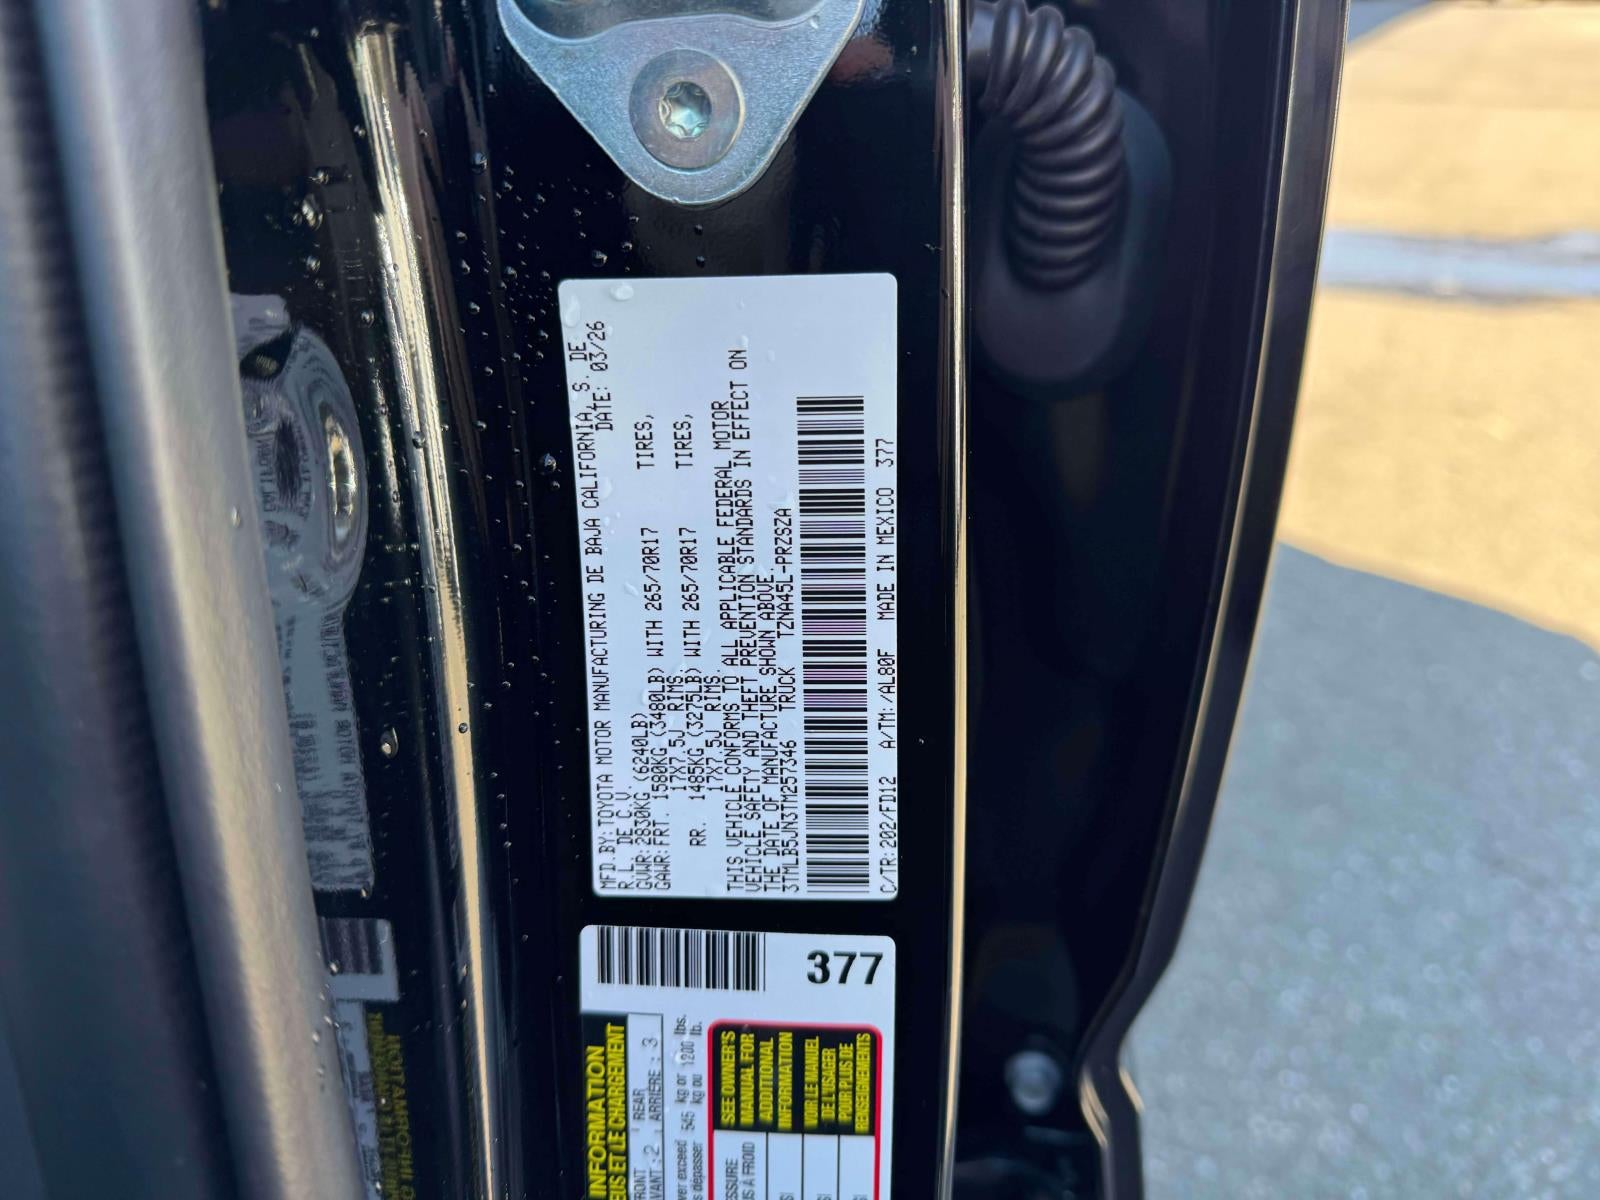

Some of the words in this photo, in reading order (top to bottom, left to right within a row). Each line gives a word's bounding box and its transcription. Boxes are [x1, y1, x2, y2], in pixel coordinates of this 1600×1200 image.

[568, 342, 587, 361] DE
[586, 321, 608, 372] 03/26
[728, 349, 748, 370] ON
[572, 375, 590, 392] S.
[592, 386, 613, 431] DATE:
[711, 401, 731, 449] MOTOR
[730, 381, 750, 440] EFFECT
[575, 405, 599, 508] CALIFORNIA,
[634, 414, 655, 469] TIRES,
[673, 414, 693, 469] TIRES,
[733, 450, 752, 468] IN
[875, 438, 894, 468] 377
[715, 461, 734, 526] FEDERAL
[734, 479, 754, 564] STANDARDS
[875, 487, 894, 544] MEXICO
[584, 518, 603, 555] BAJA
[586, 566, 604, 583] DE
[641, 527, 662, 610] 265/70R17
[679, 527, 700, 610] 265/70R17
[876, 555, 894, 571] IN
[717, 537, 737, 629] APPLICABLE
[757, 567, 774, 620] ABOVE.
[877, 582, 895, 620] MADE
[645, 621, 664, 656] WITH
[683, 621, 701, 656] WITH
[738, 574, 757, 666] PREVENTION
[588, 593, 610, 711] MANUFACTURING
[720, 640, 738, 666] ALL
[758, 630, 776, 675] SHOWN
[648, 667, 667, 736] (3480LB)
[667, 669, 685, 711] RIMS.
[685, 667, 704, 736] (3275LB)
[704, 670, 722, 711] RIMS.
[722, 676, 739, 693] TO
[740, 676, 758, 720] THEFT
[778, 667, 797, 711] TRUCK
[594, 721, 612, 764] MOTOR
[631, 712, 649, 781] (6240LB)
[723, 703, 741, 775] CONFORMS
[742, 731, 759, 758] AND
[759, 686, 779, 785] MANUFACTURE
[651, 747, 668, 800] 1580KG
[669, 730, 687, 791] 17X7.5J
[687, 748, 705, 800] 1485KG
[706, 730, 724, 791] 17X7.5J
[616, 785, 633, 818] C.V.
[743, 767, 760, 821] SAFETY
[762, 794, 779, 811] OF
[690, 822, 707, 847] RR.
[725, 785, 742, 847] VEHICLE
[780, 739, 799, 893] 3TMLB5JN3TM257346
[617, 828, 633, 845] DE
[763, 822, 780, 856] DATE
[619, 857, 634, 890] R.L.
[727, 856, 743, 892] THIS
[744, 830, 762, 892] VEHICLE
[763, 866, 780, 892] THE
[807, 950, 882, 985] 377
[642, 1037, 658, 1047] 3
[674, 1014, 687, 1035] lbs.
[690, 1022, 702, 1035] lb.
[680, 1040, 695, 1066] 1200
[721, 1030, 736, 1095] OWNER'S
[741, 1033, 755, 1062] FOR
[805, 1036, 819, 1082] MANUEL
[839, 1043, 853, 1058] DE
[606, 1023, 625, 1130] CHARGEMENT
[675, 1073, 687, 1086] or
[692, 1074, 702, 1087] ou
[759, 1037, 774, 1121] ADDITIONAL
[778, 1032, 793, 1129] INFORMATION
[804, 1083, 818, 1098] LE
[822, 1048, 836, 1101] L'USAGER
[839, 1060, 853, 1089] PLUS
[855, 1033, 870, 1132] RENSEIGNEMENTS
[633, 1089, 645, 1121] REAR
[674, 1089, 690, 1104] kg
[690, 1089, 705, 1104] kg
[720, 1097, 735, 1125] SEE
[740, 1065, 754, 1124] MANUAL
[804, 1099, 818, 1127] VOIR
[822, 1103, 835, 1120] DE
[839, 1090, 852, 1121] POUR
[586, 1045, 606, 1198] INFORMATION
[681, 1111, 695, 1131] 545
[608, 1131, 625, 1152] LE
[643, 1145, 660, 1156] 2
[674, 1139, 687, 1180] exceed
[742, 1142, 755, 1176] FROID
[608, 1153, 626, 1173] ET
[649, 1168, 661, 1200] VANT
